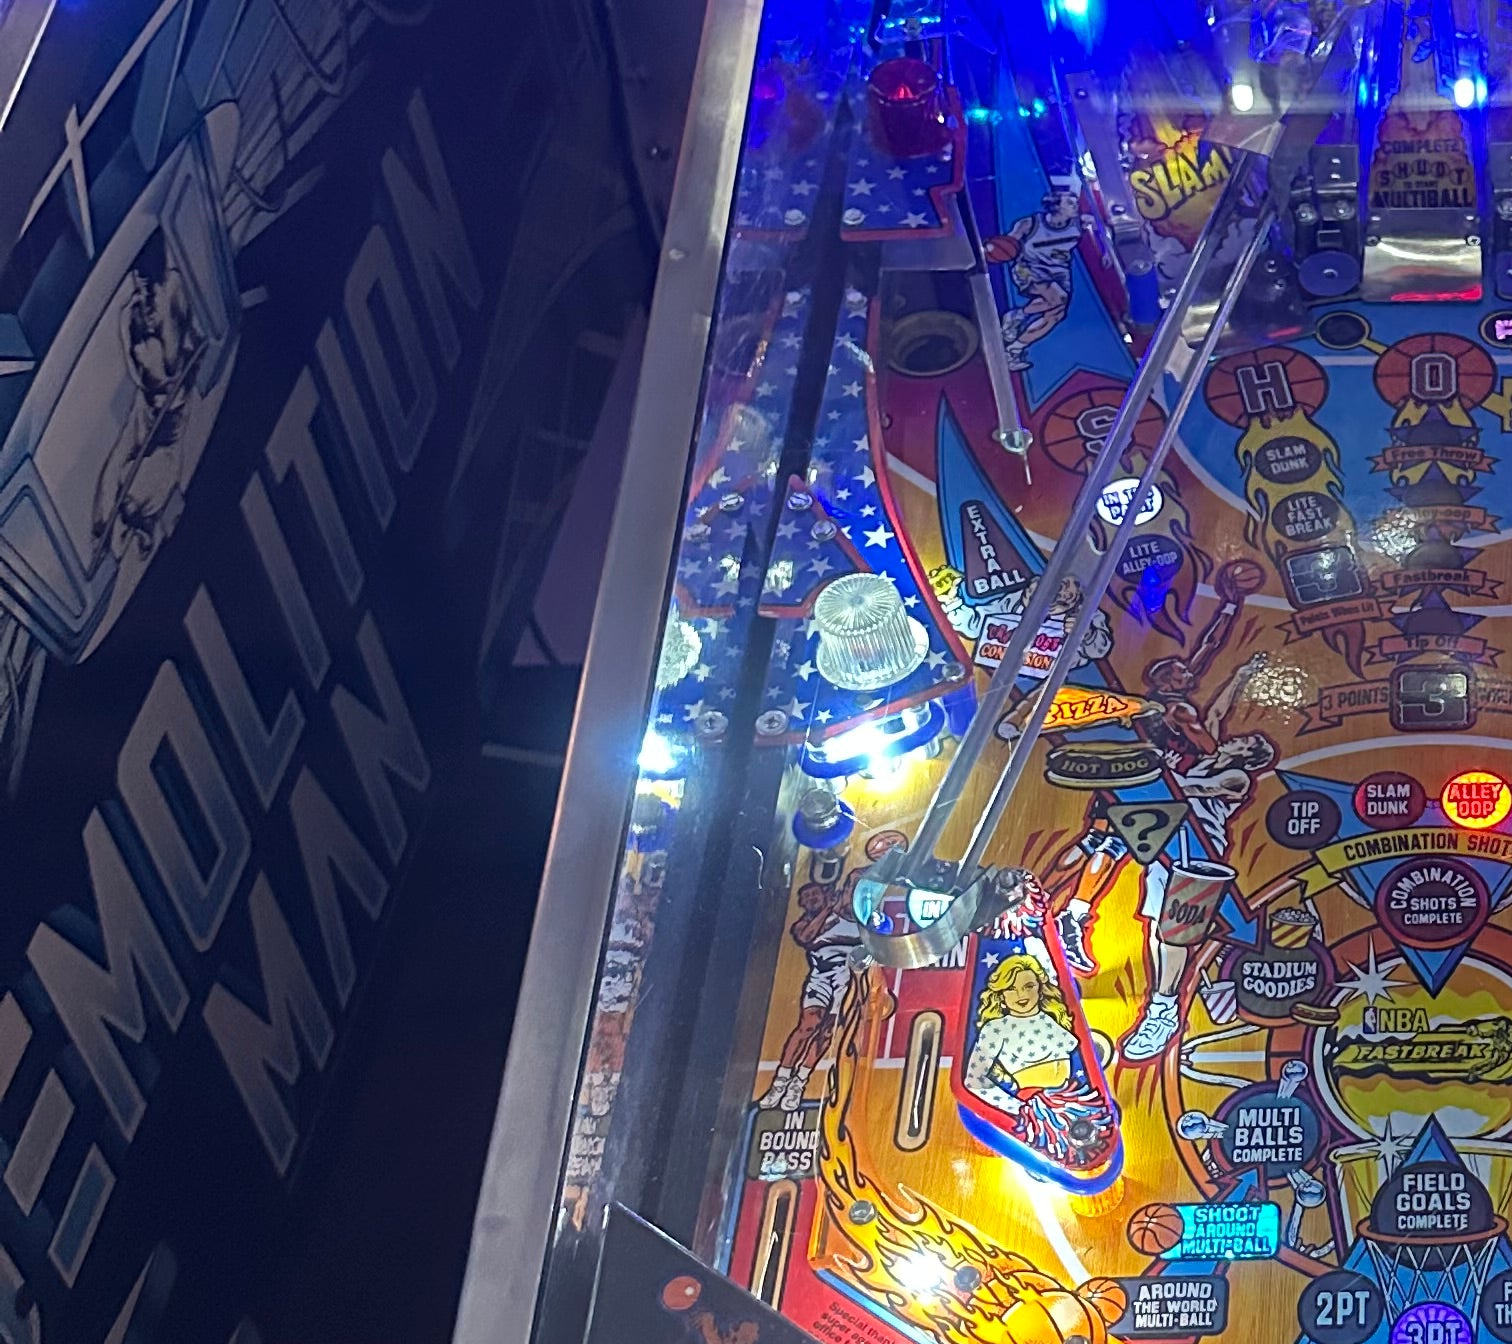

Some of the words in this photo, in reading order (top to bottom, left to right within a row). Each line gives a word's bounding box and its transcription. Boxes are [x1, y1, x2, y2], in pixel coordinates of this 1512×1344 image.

[1236, 361, 1294, 413] H
[1411, 353, 1459, 400] O
[1265, 443, 1307, 461] SLAM
[1271, 458, 1309, 475] DUNK
[1288, 496, 1317, 513] LITE
[1287, 507, 1324, 523] FAST
[1285, 519, 1333, 538] BREAK
[967, 505, 1001, 573] EXTRA
[1130, 541, 1161, 559] LITE
[974, 569, 1026, 595] BALL
[1393, 569, 1470, 583] Fastbreak
[1404, 635, 1430, 650] Tip
[1337, 686, 1389, 707] POINTS
[1047, 696, 1128, 724] PIZZA
[1061, 760, 1099, 774] HOT
[1110, 758, 1149, 773] DOG
[1367, 783, 1411, 798] SLAM
[1450, 782, 1501, 801] ALLEY
[1291, 802, 1319, 818] TIP
[1367, 800, 1409, 815] DUNK
[1458, 800, 1495, 817] OOP
[1288, 818, 1321, 835] OFF
[1343, 832, 1458, 861] COMBINATION
[203, 610, 432, 1176] MAN
[1390, 867, 1477, 909] COMBINATION
[1410, 897, 1457, 911] SHOTS
[1404, 913, 1462, 925] COMPLETE
[1242, 960, 1318, 978] STADIUM
[1243, 976, 1316, 999] GOODIES
[1380, 1008, 1429, 1032] NBA
[1357, 1042, 1490, 1060] FASTBREAK
[785, 1111, 805, 1130] IN
[1239, 1106, 1301, 1127] MULTI
[760, 1131, 821, 1150] BOUND
[1234, 1126, 1304, 1146] BALLS
[1233, 1147, 1303, 1163] COMPLETE
[1403, 1172, 1465, 1193] FIELD
[1395, 1192, 1472, 1213] GOALS
[1195, 1206, 1263, 1224] SHOOT
[1397, 1212, 1469, 1231] COMPLETE
[1195, 1222, 1257, 1239] AROUND
[1180, 1236, 1271, 1256] MULTI-BALL
[1139, 1282, 1214, 1301] AROUND
[1132, 1300, 1161, 1316] THE
[1166, 1299, 1218, 1315] WORLD
[1315, 1289, 1371, 1326] 2PT
[1134, 1313, 1214, 1330] MULTI-BALL
